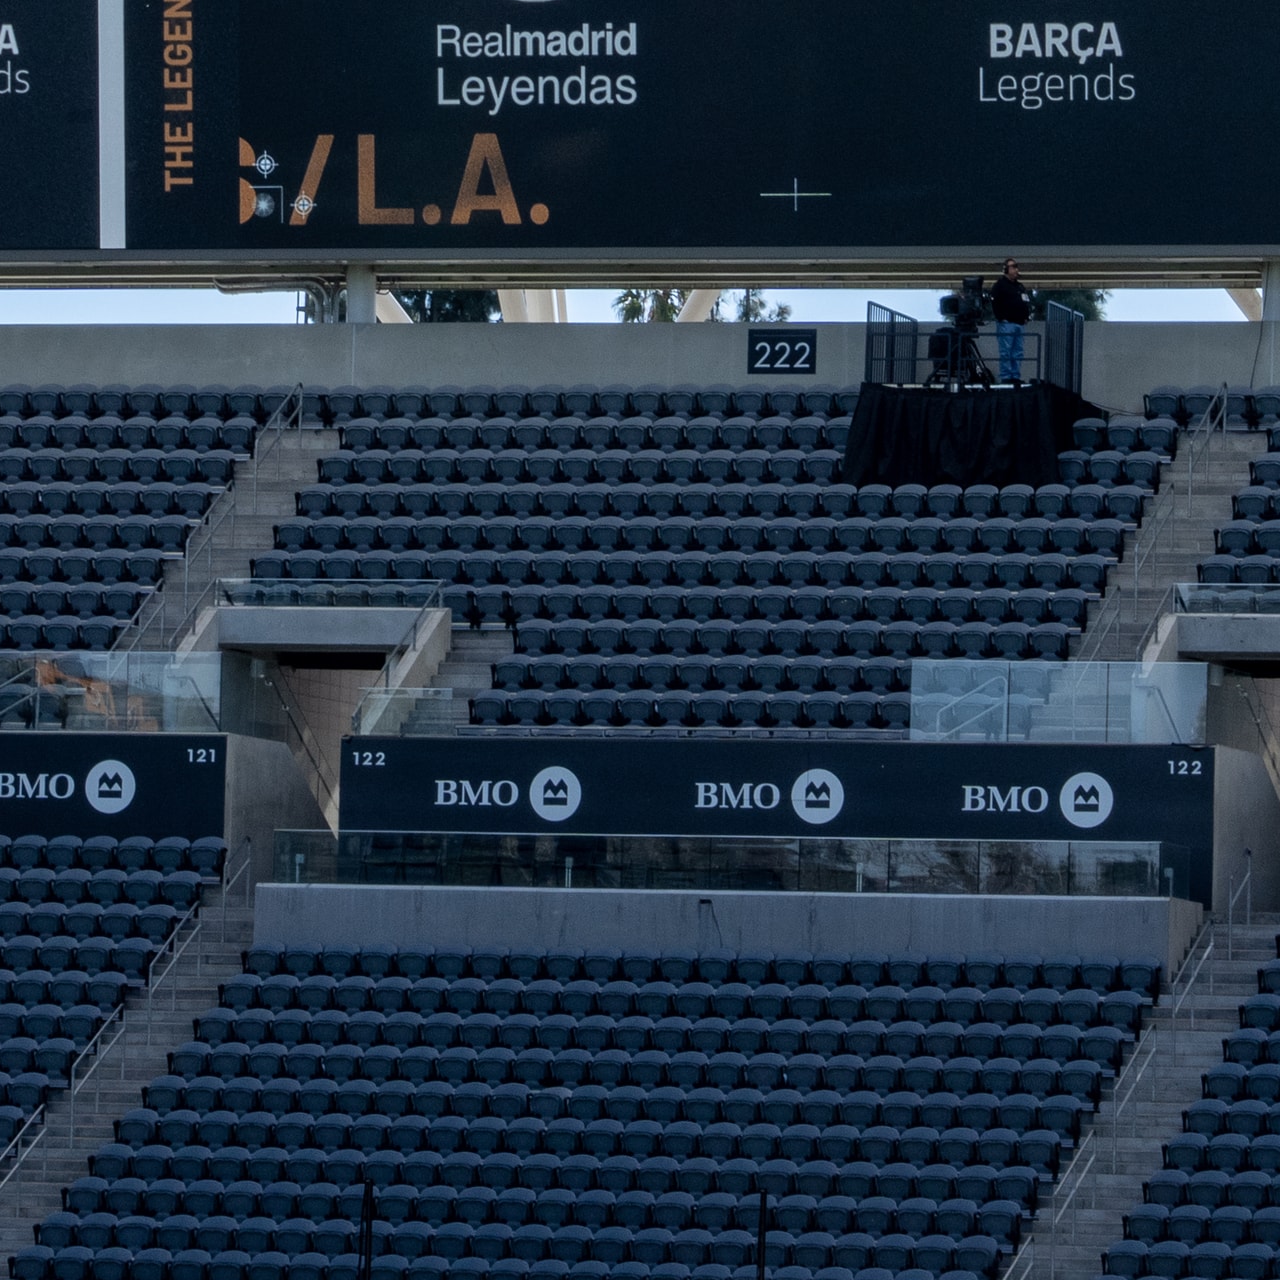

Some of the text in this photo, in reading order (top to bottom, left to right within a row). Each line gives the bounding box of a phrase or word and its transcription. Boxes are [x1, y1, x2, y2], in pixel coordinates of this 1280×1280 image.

[437, 23, 636, 57] Realmadrid
[989, 22, 1122, 63] BARÇA
[438, 66, 637, 115] Leyendas
[980, 63, 1135, 109] Legends
[164, 122, 193, 192] THE
[754, 342, 810, 367] 222
[188, 749, 215, 762] 121
[353, 752, 385, 765] 122
[1168, 761, 1201, 774] 122
[435, 780, 518, 806] BMO
[695, 783, 780, 809] BMO
[962, 786, 1048, 812] BMO
